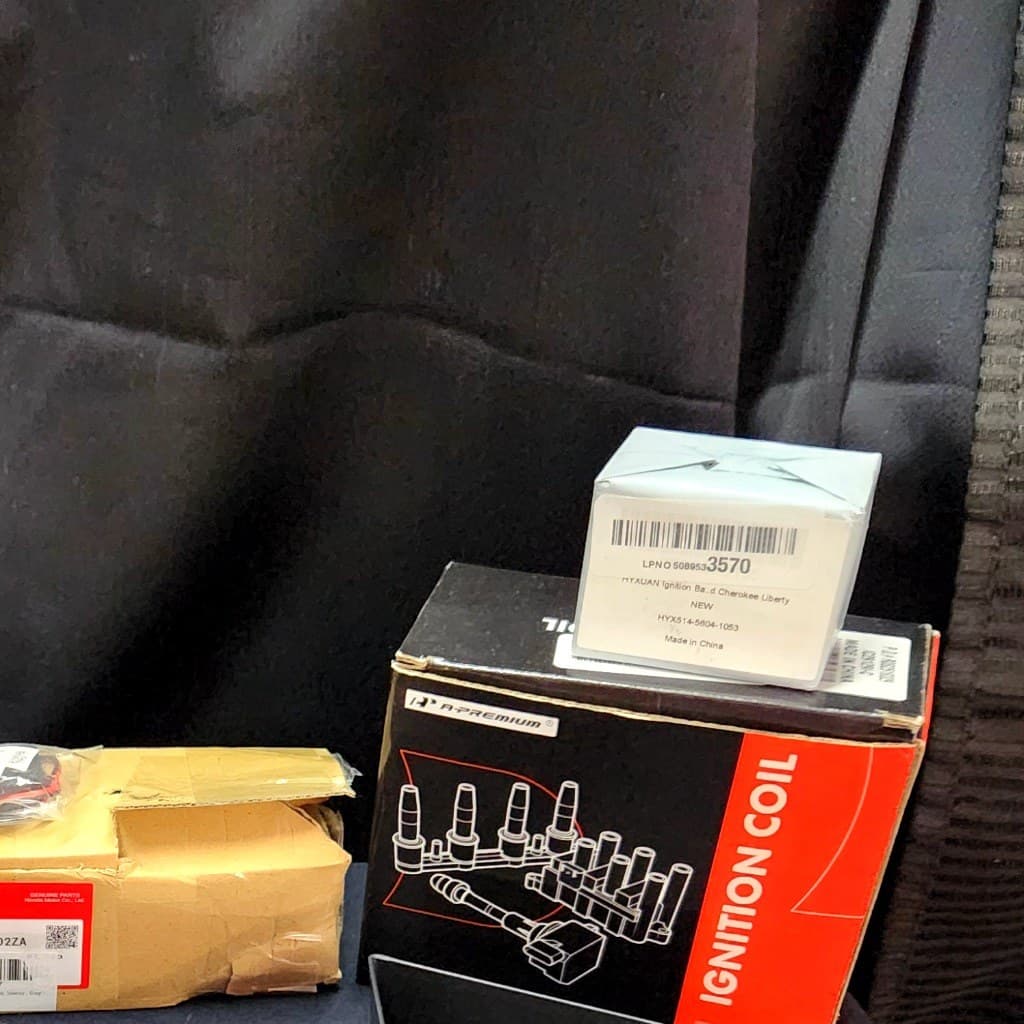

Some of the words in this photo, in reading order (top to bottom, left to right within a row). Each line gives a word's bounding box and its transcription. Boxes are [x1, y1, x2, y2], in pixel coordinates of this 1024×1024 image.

[661, 579, 693, 593] Ignition
[718, 587, 760, 602] Cherokee
[761, 593, 792, 606] Liberty
[690, 600, 715, 611] NEW
[664, 634, 688, 645] Made
[689, 638, 698, 647] in
[699, 639, 725, 651] China
[440, 703, 543, 730] A-PREMIUM
[698, 845, 774, 1007] IGNITION
[743, 752, 799, 839] COIL
